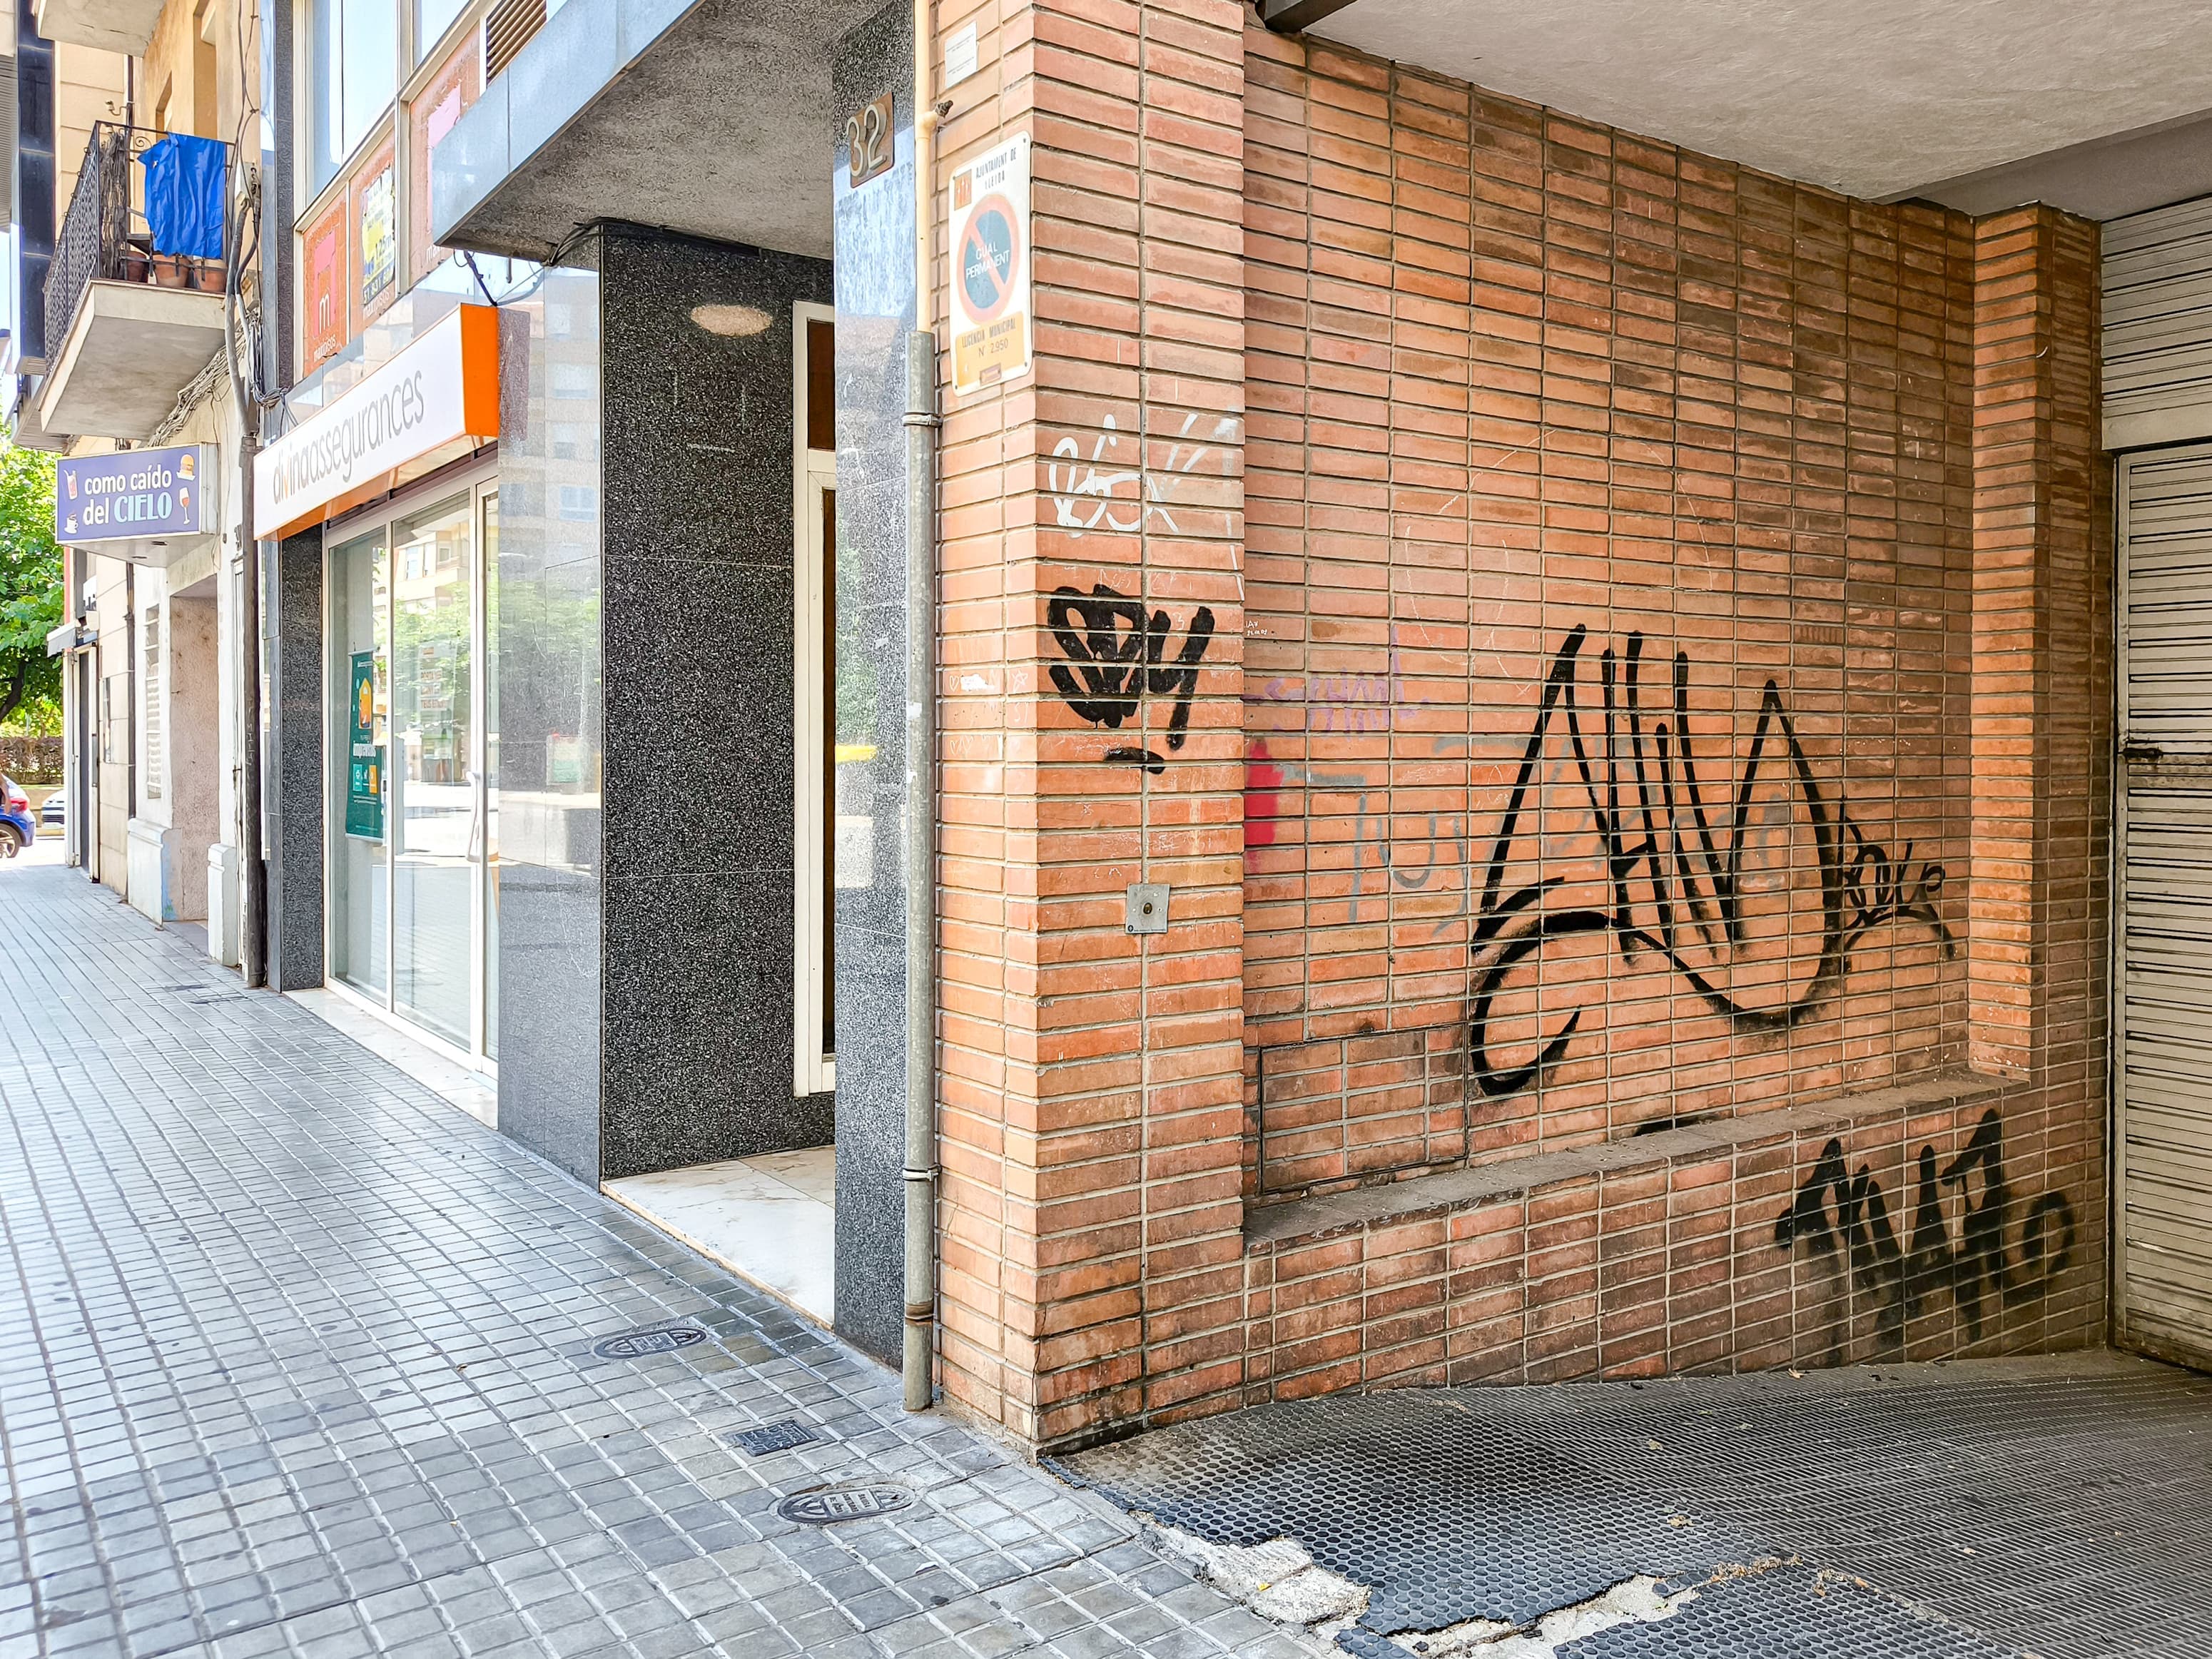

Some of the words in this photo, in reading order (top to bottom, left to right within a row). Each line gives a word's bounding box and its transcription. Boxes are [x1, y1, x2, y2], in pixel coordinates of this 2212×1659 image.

[846, 103, 886, 177] 32
[976, 151, 1008, 178] AJUNTAMENT
[1010, 146, 1016, 161] DE
[965, 250, 1010, 280] PERMANENT
[84, 474, 126, 495] como
[130, 464, 172, 491] caído
[83, 497, 110, 525] del
[114, 492, 173, 523] CIELO
